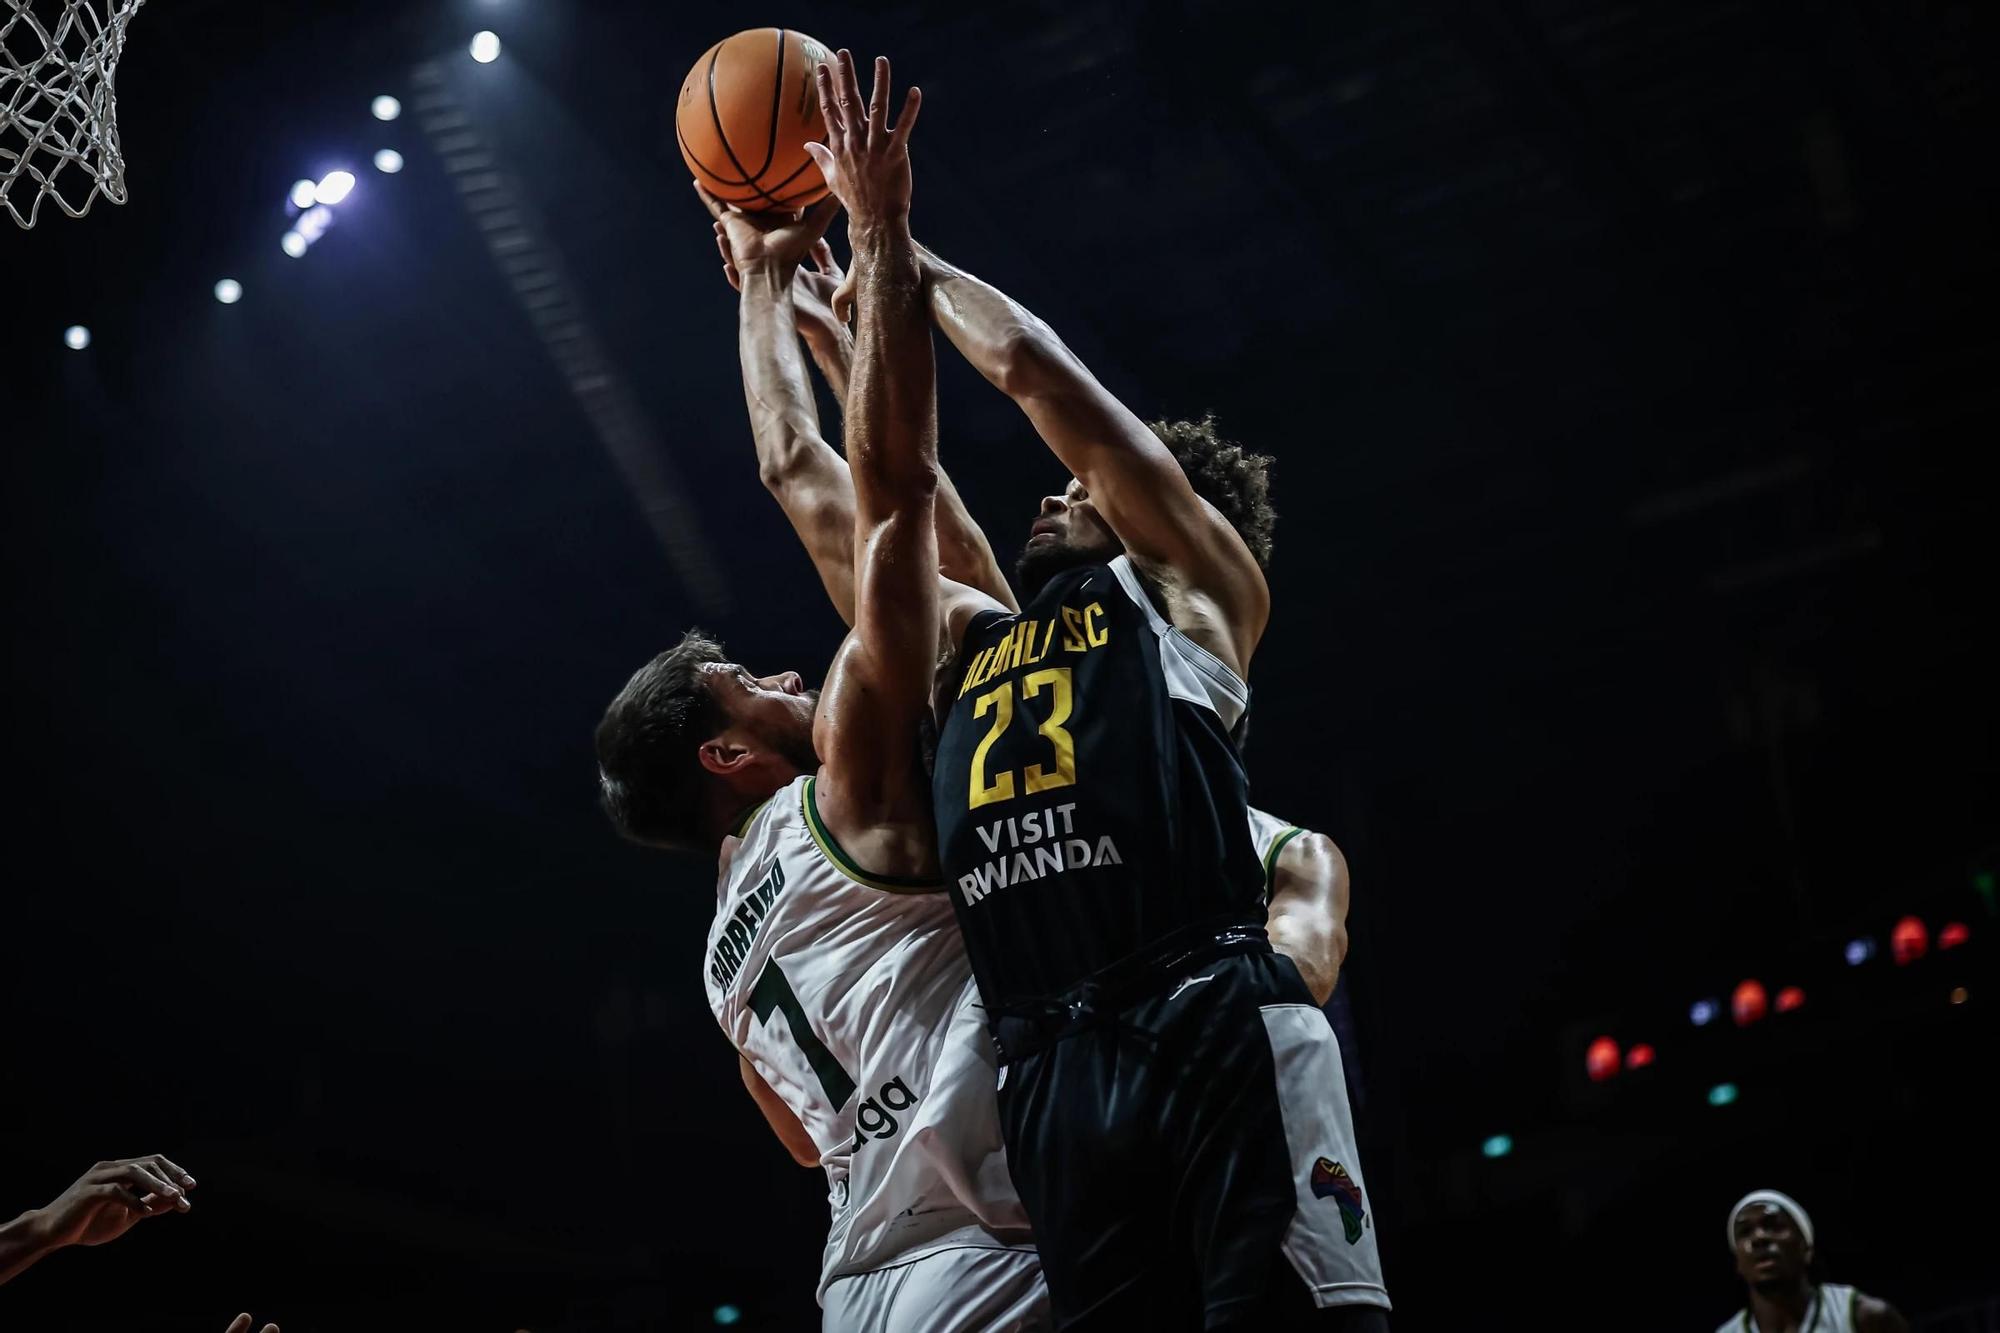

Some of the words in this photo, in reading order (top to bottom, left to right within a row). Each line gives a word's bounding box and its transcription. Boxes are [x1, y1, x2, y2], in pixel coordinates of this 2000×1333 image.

[1061, 602, 1109, 652] SC
[969, 667, 1077, 810] 23
[975, 802, 1077, 854] VISIT
[957, 835, 1123, 907] RWANDA
